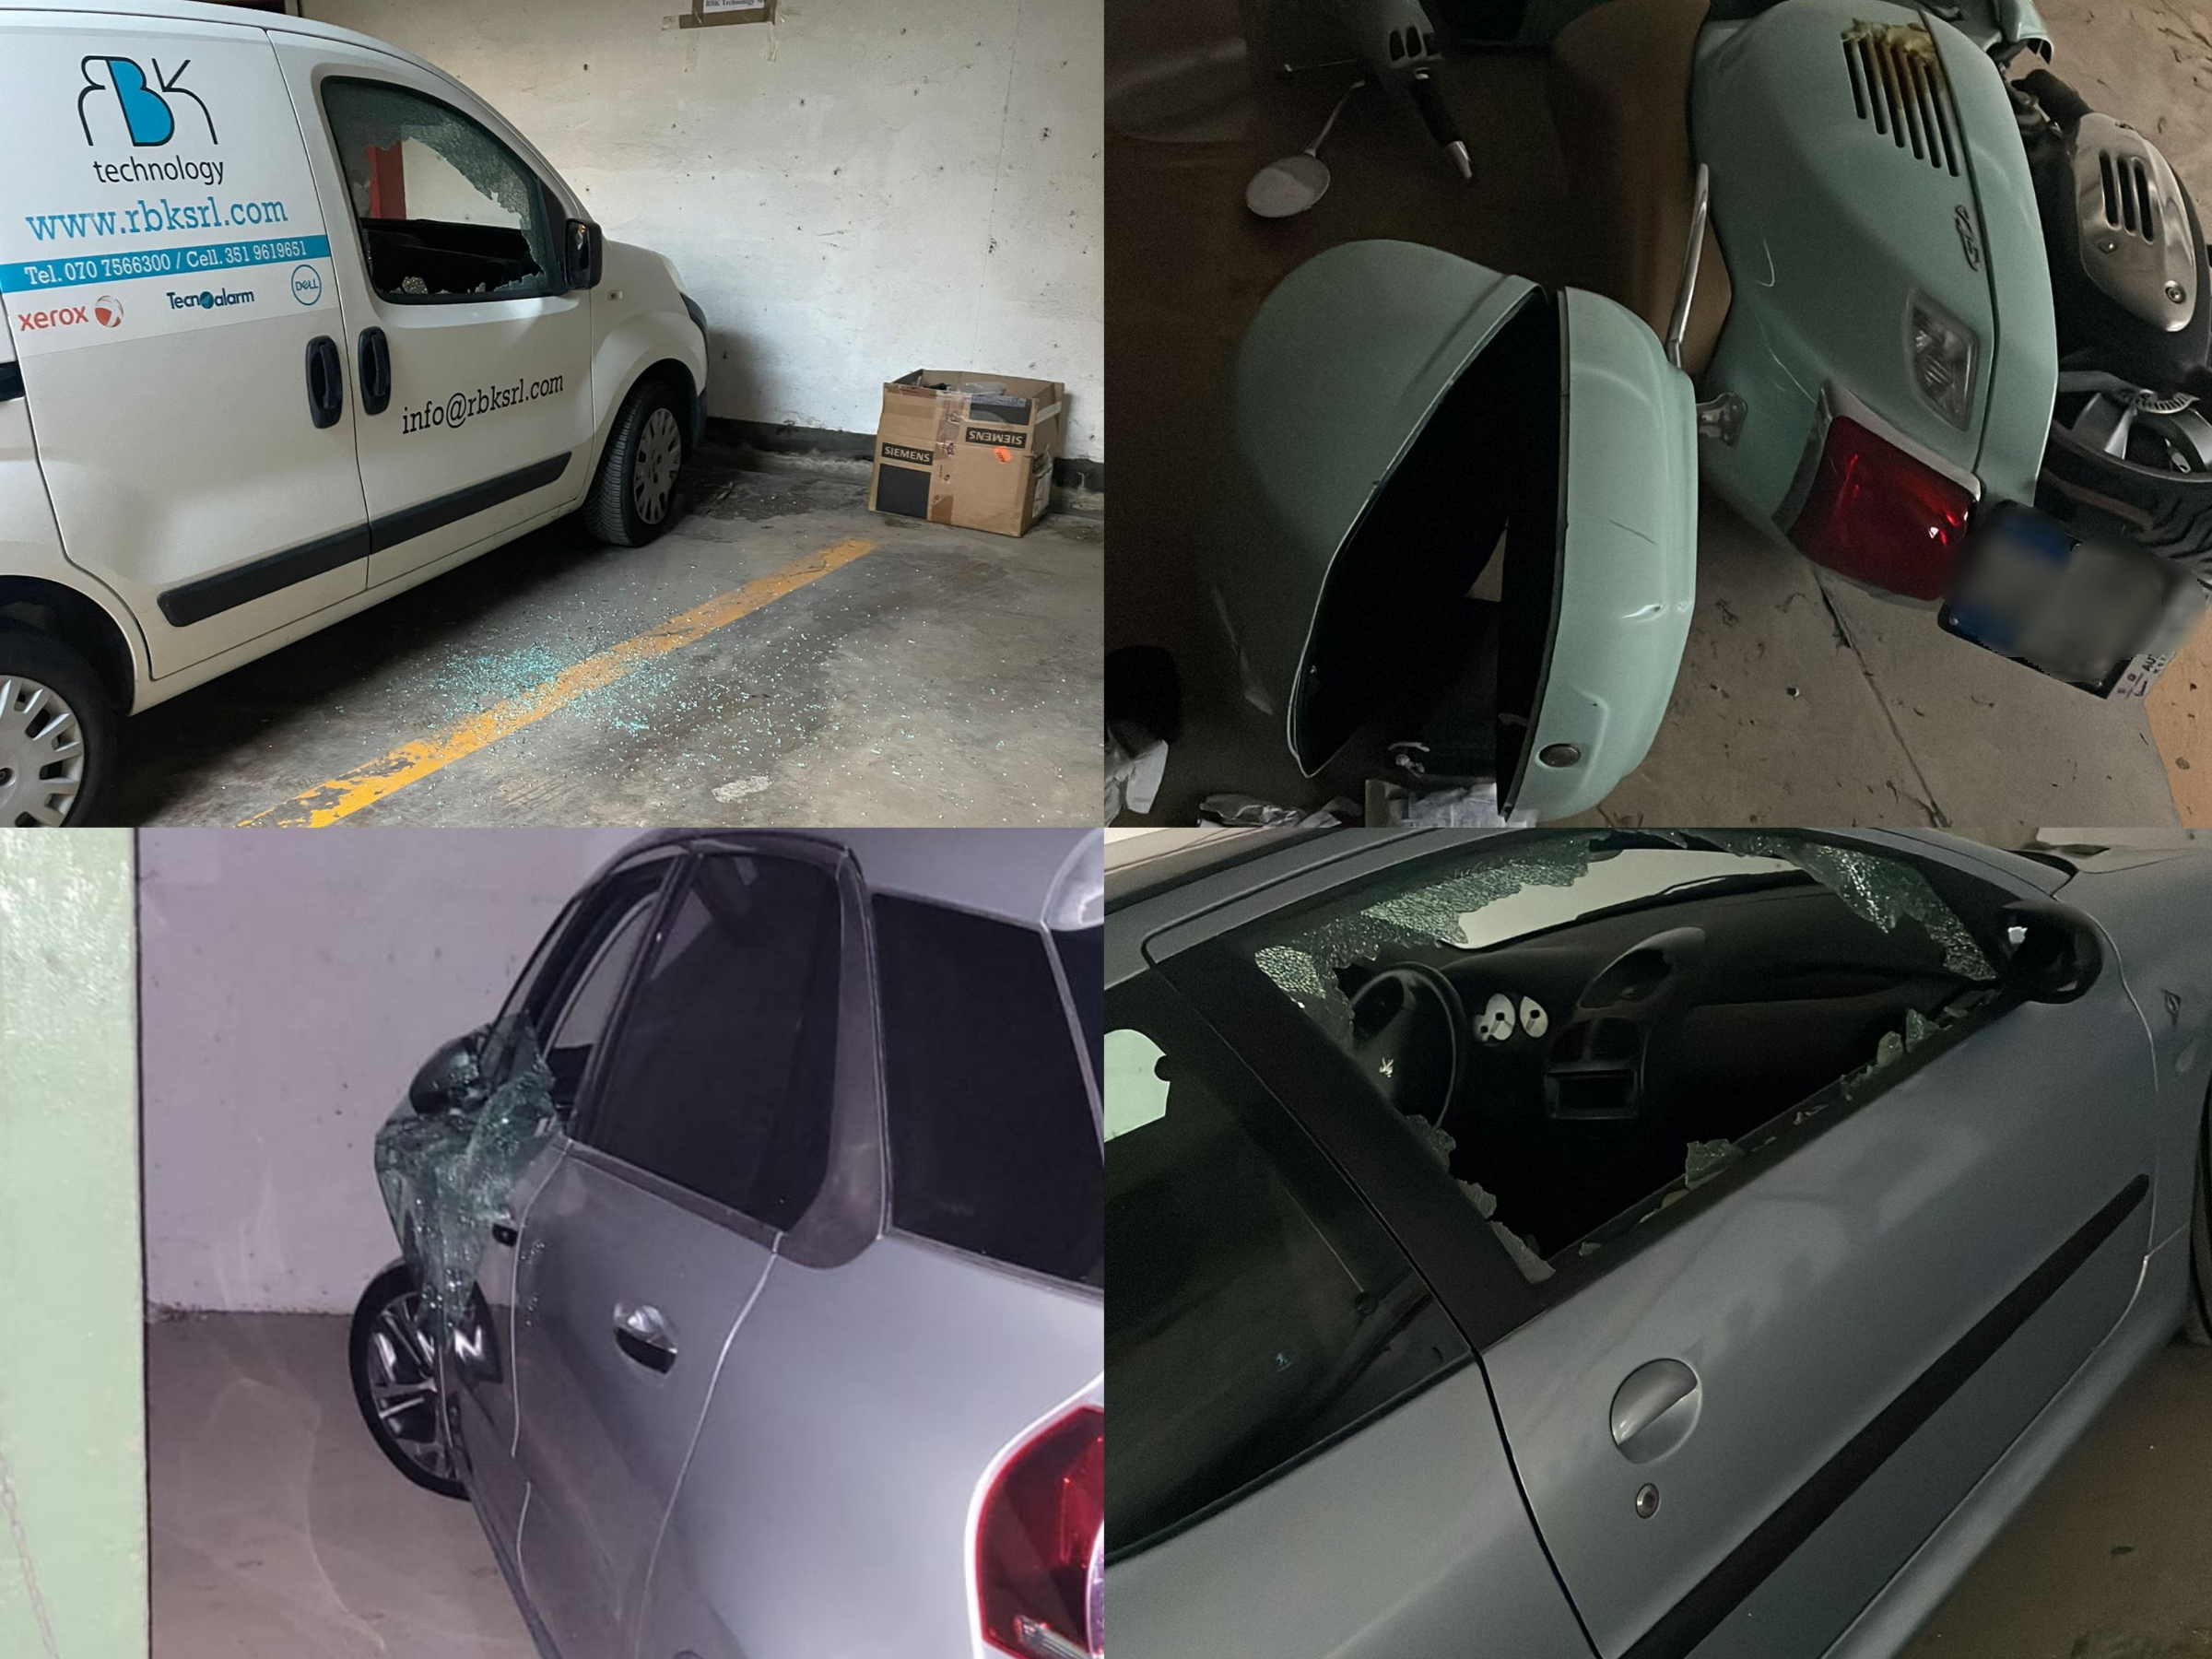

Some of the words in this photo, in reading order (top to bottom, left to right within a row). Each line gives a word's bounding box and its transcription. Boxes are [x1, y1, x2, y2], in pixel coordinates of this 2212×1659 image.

[77, 54, 219, 147] RBK
[93, 155, 225, 185] technology
[25, 196, 289, 241] www.rbksrl.com
[24, 265, 63, 285] Tel.
[64, 261, 98, 281] 070
[100, 253, 171, 276] 7566300
[175, 251, 182, 270] /
[186, 249, 223, 268] Cell.
[225, 246, 251, 264] 351
[253, 241, 308, 261] 9619651
[295, 278, 320, 291] DELL
[166, 288, 255, 310] Tecnoalarm
[18, 306, 89, 332] xerox
[402, 374, 564, 435] info@rbksrl.com
[968, 429, 1024, 446] SIEMENS
[884, 446, 931, 463] SIEMENS
